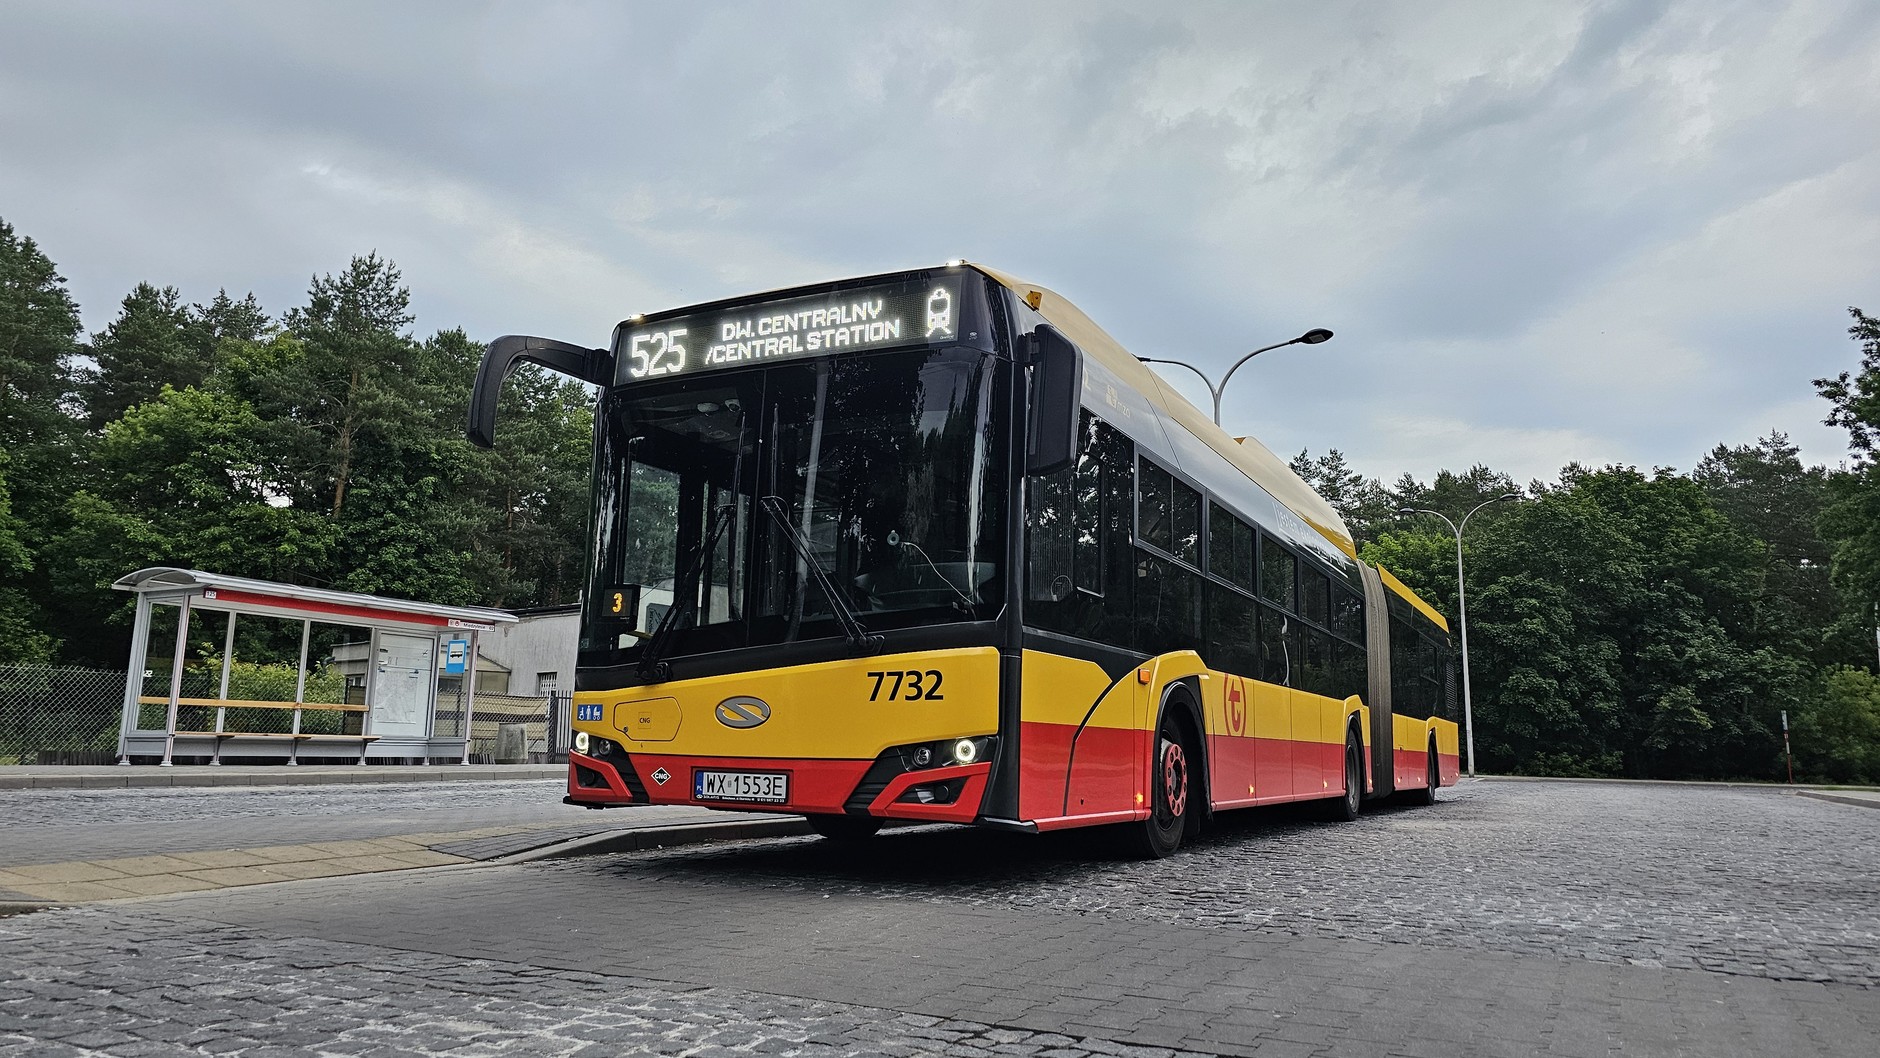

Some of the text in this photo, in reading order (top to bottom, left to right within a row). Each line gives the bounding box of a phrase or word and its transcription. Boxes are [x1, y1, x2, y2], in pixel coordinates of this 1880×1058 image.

[722, 299, 882, 341] DW. CENTRALNY
[630, 328, 688, 377] 525
[704, 319, 901, 365] /CENTRAL STATION
[612, 592, 623, 613] 3
[867, 669, 944, 702] 7732
[654, 772, 668, 780] CNG
[706, 774, 783, 797] WX 1553E
